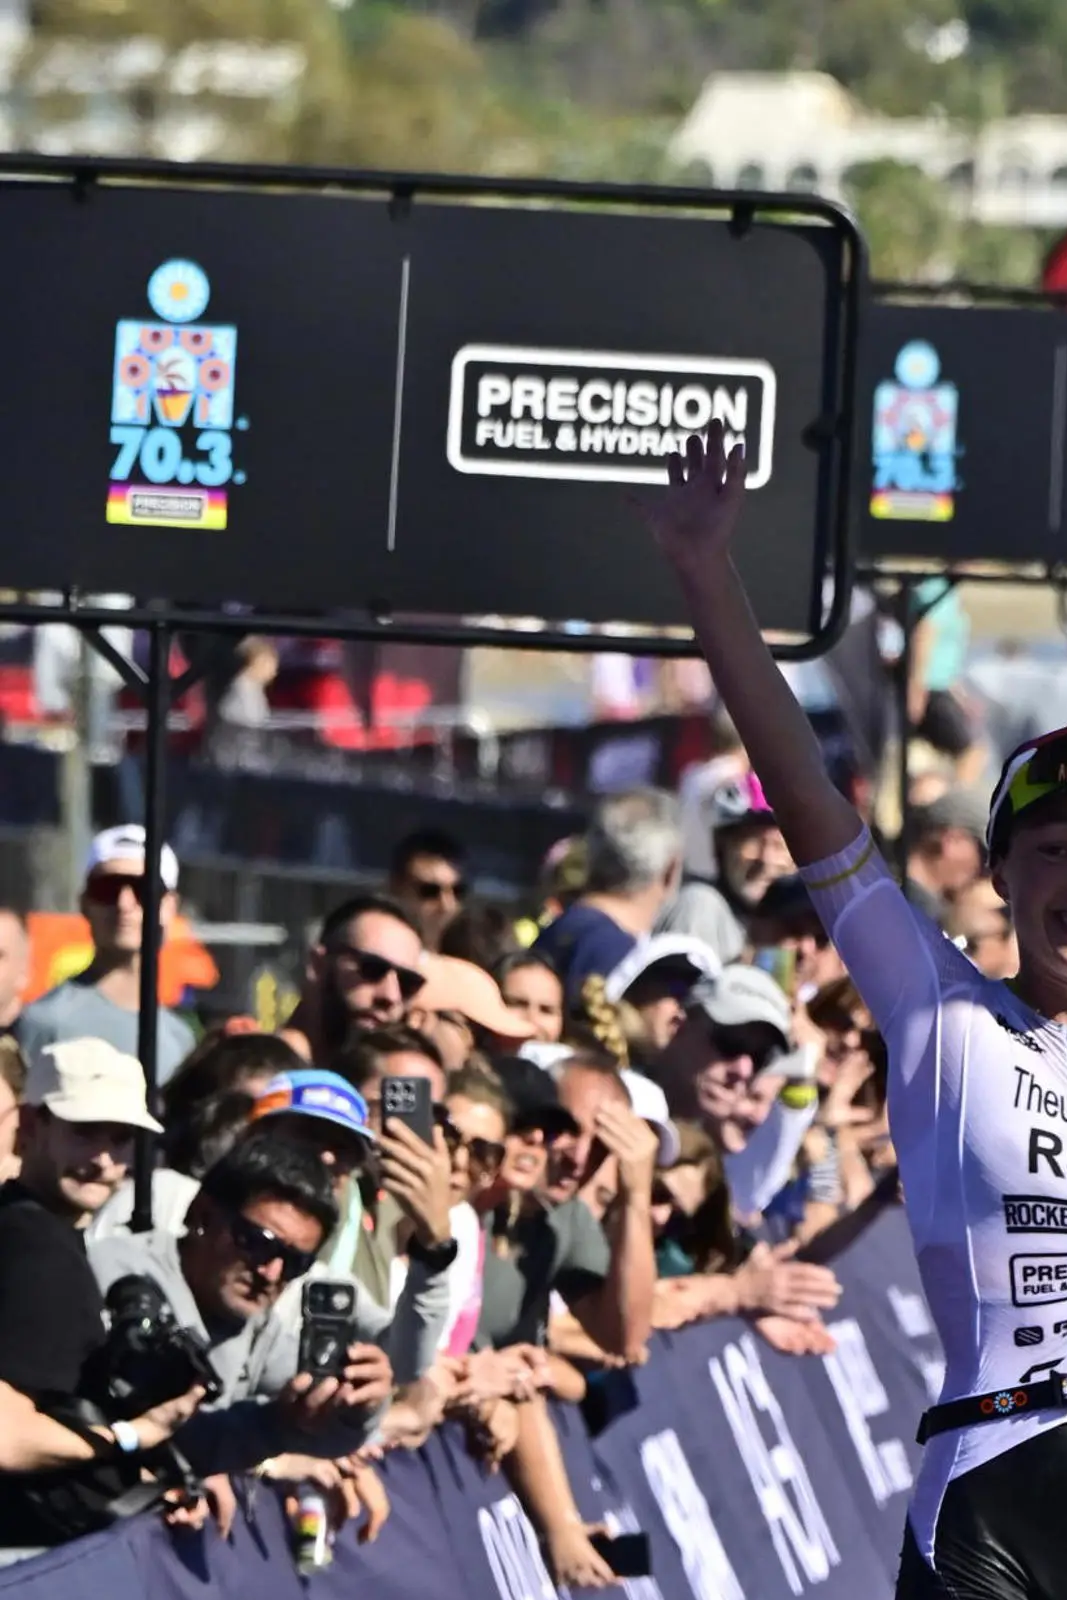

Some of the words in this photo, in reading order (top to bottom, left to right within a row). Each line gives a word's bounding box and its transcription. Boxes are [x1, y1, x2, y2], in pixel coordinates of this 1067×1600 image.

[477, 373, 748, 431] PRECISION
[109, 425, 234, 487] 70.3
[475, 418, 551, 450] FUEL
[555, 422, 577, 452] &
[580, 424, 746, 461] HYDRATN
[1023, 1284, 1056, 1296] FUEL
